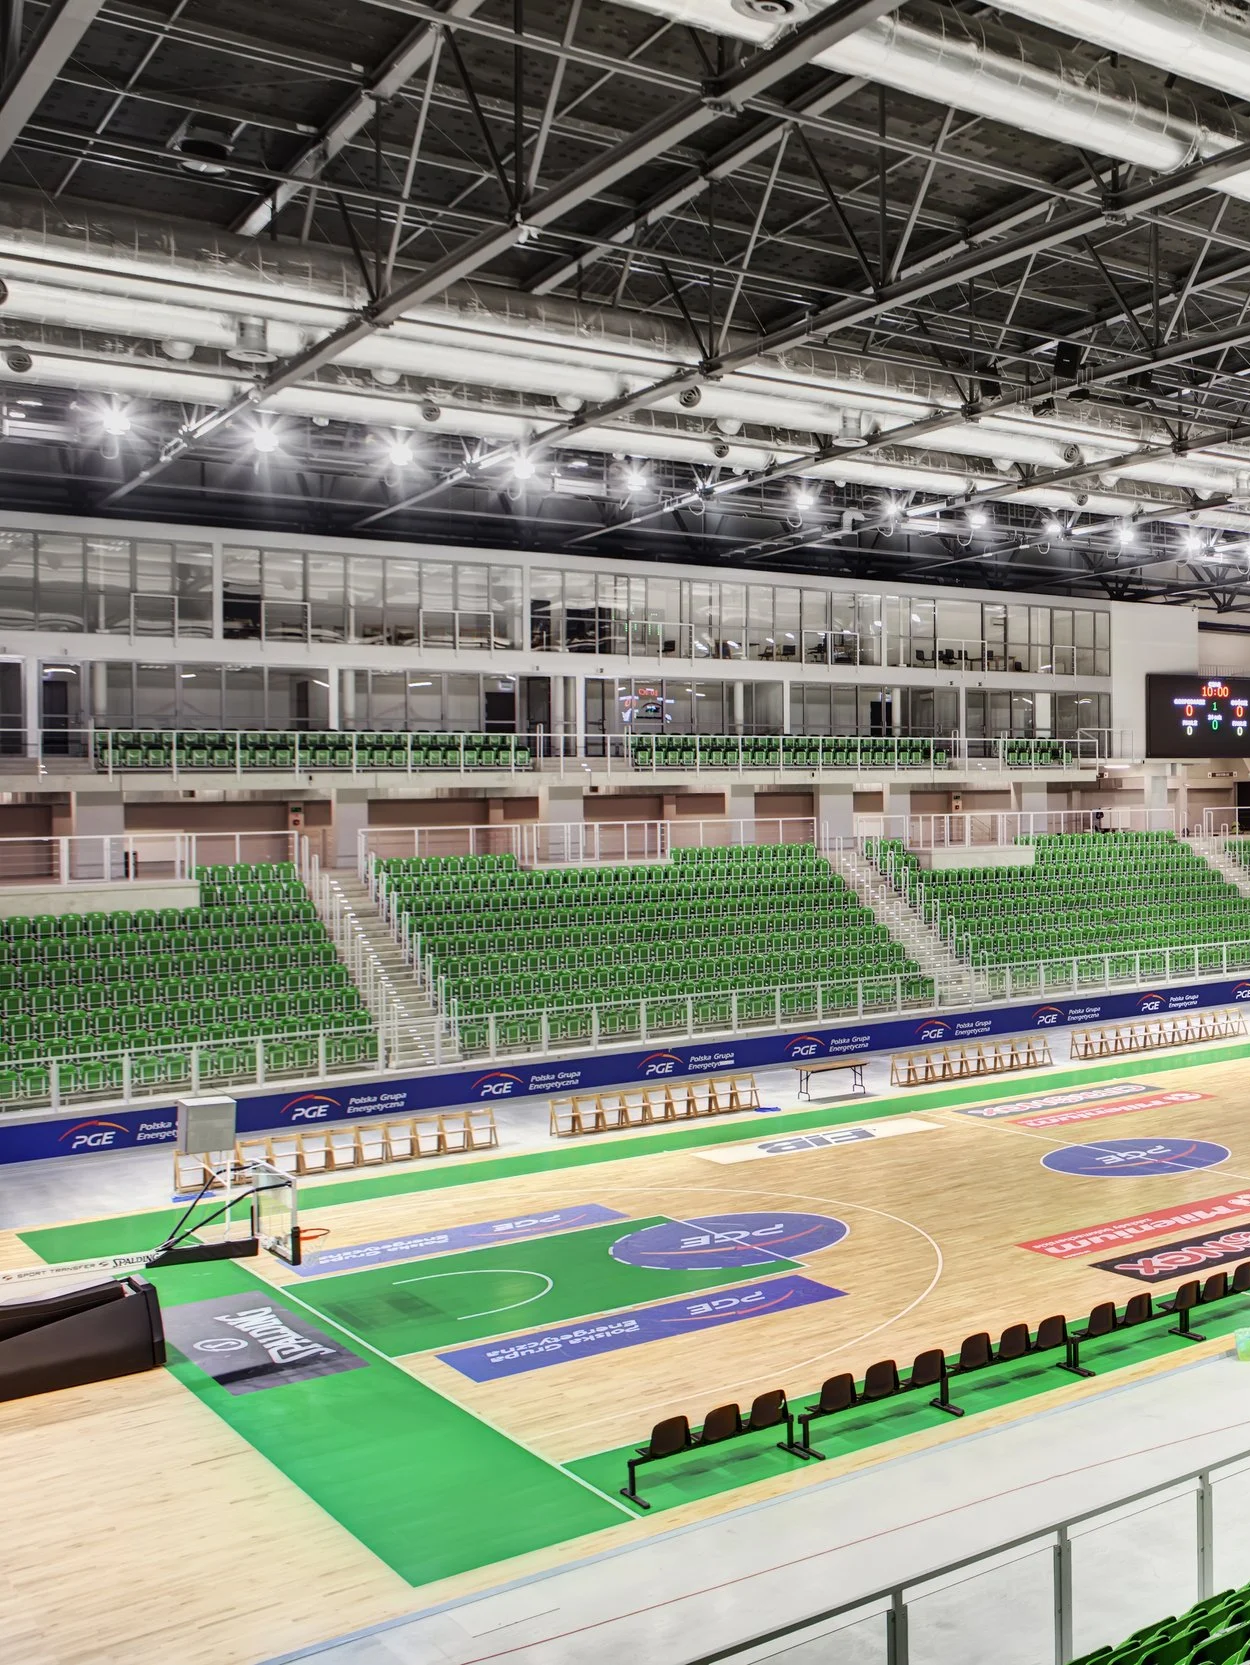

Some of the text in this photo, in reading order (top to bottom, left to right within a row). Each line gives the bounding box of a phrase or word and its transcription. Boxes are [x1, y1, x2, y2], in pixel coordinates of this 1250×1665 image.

[1202, 686, 1229, 697] 10:00
[1186, 704, 1193, 716] 0
[1212, 702, 1217, 711] 1
[1236, 705, 1243, 717] 0
[1168, 1000, 1198, 1009] Energetyczna
[1169, 994, 1199, 1003] Polska Grupa
[1068, 1006, 1101, 1015] Polska Grupa
[1141, 1001, 1160, 1011] PGE
[1037, 1014, 1057, 1025] PGE
[1067, 1012, 1100, 1022] Energetyczna
[956, 1020, 991, 1029] Polska Grupa
[921, 1028, 944, 1040] PGE
[955, 1026, 991, 1036] Energetyczna
[830, 1034, 870, 1045] Polska Grupa
[791, 1044, 817, 1057] PGE
[829, 1041, 869, 1053] Energetyczna
[690, 1051, 735, 1063] Polska Grupa
[645, 1061, 675, 1075] PGE
[530, 1070, 581, 1082] Polska Grupa
[481, 1082, 513, 1097] PGE
[529, 1078, 580, 1091] Energetyczna
[349, 1091, 407, 1105] Polska Grupa
[292, 1105, 329, 1121] PGE
[347, 1100, 406, 1114] Energetyczna
[139, 1121, 172, 1131] Polska
[72, 1131, 117, 1149] PGE
[1095, 1144, 1172, 1164] PGE
[493, 1213, 561, 1232] PGE
[1044, 1202, 1242, 1255] Milenium
[680, 1223, 784, 1249] PGE
[112, 1252, 160, 1269] SPALDING
[17, 1263, 96, 1279] SPORT TRANSFER
[686, 1290, 765, 1316] PGE
[213, 1306, 336, 1364] SPALDING
[486, 1319, 637, 1358] Energetyczna
[490, 1324, 640, 1364] Polska Grupa
